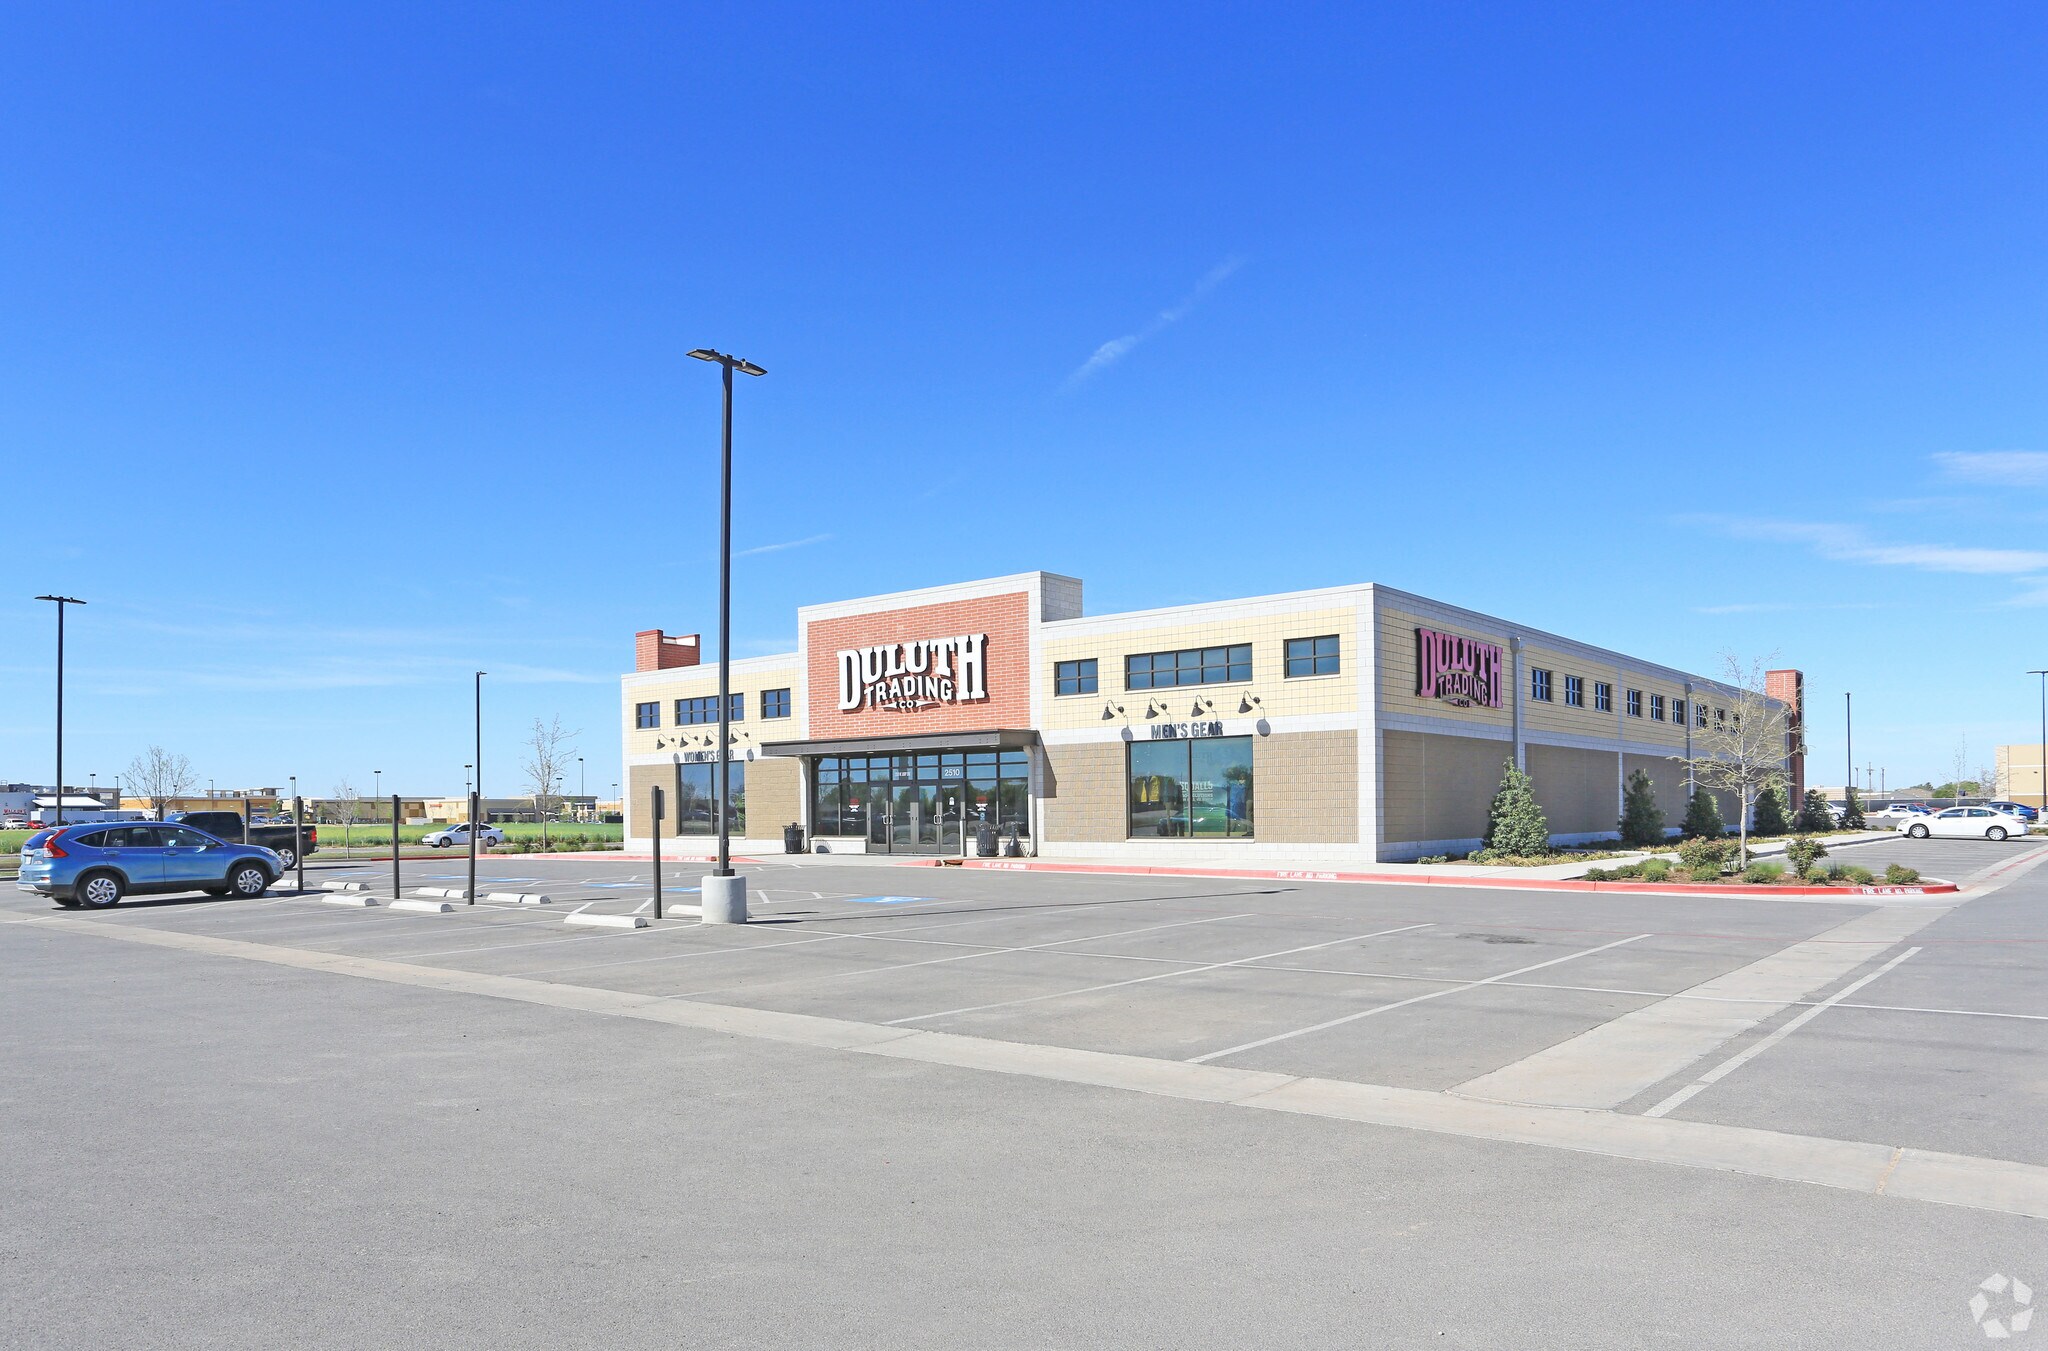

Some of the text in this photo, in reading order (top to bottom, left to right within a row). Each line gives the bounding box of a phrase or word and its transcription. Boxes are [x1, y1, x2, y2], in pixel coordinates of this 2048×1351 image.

[837, 634, 985, 710] DULUTH
[1420, 628, 1503, 708] DULUTH
[864, 676, 953, 707] TRADING
[1438, 673, 1487, 706] TRADING
[900, 699, 914, 709] CO
[1151, 721, 1223, 739] MEN'S GEAR
[684, 750, 715, 762] WOMEN'S
[944, 768, 960, 777] 2510
